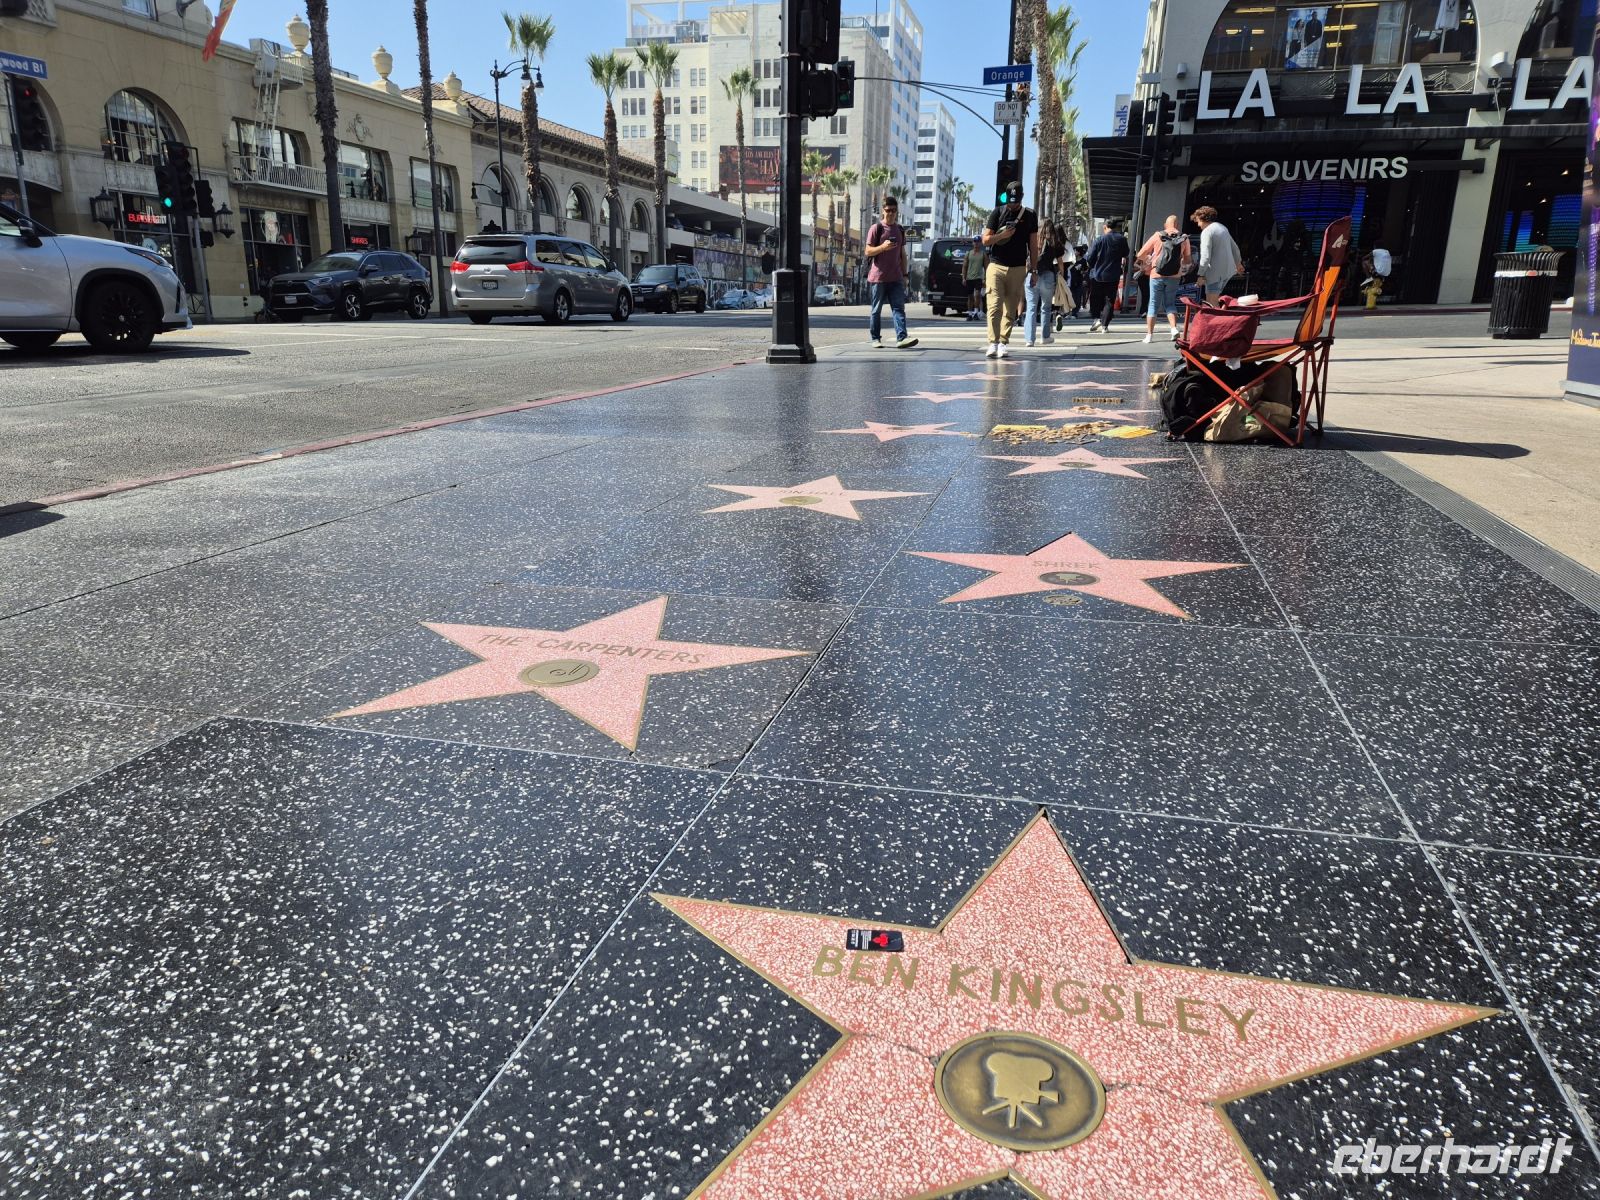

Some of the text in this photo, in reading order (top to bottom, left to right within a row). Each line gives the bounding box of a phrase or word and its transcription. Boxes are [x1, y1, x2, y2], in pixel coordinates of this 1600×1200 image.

[32, 61, 44, 74] Bl
[991, 70, 1025, 82] Orange
[1196, 55, 1595, 119] LA LA LA
[997, 103, 1006, 111] DO
[1240, 156, 1409, 182] SOUVENIRS
[1032, 560, 1101, 570] SHREK
[477, 633, 705, 664] THE CARPENTERS
[812, 944, 1258, 1042] BEN KINGSLEY
